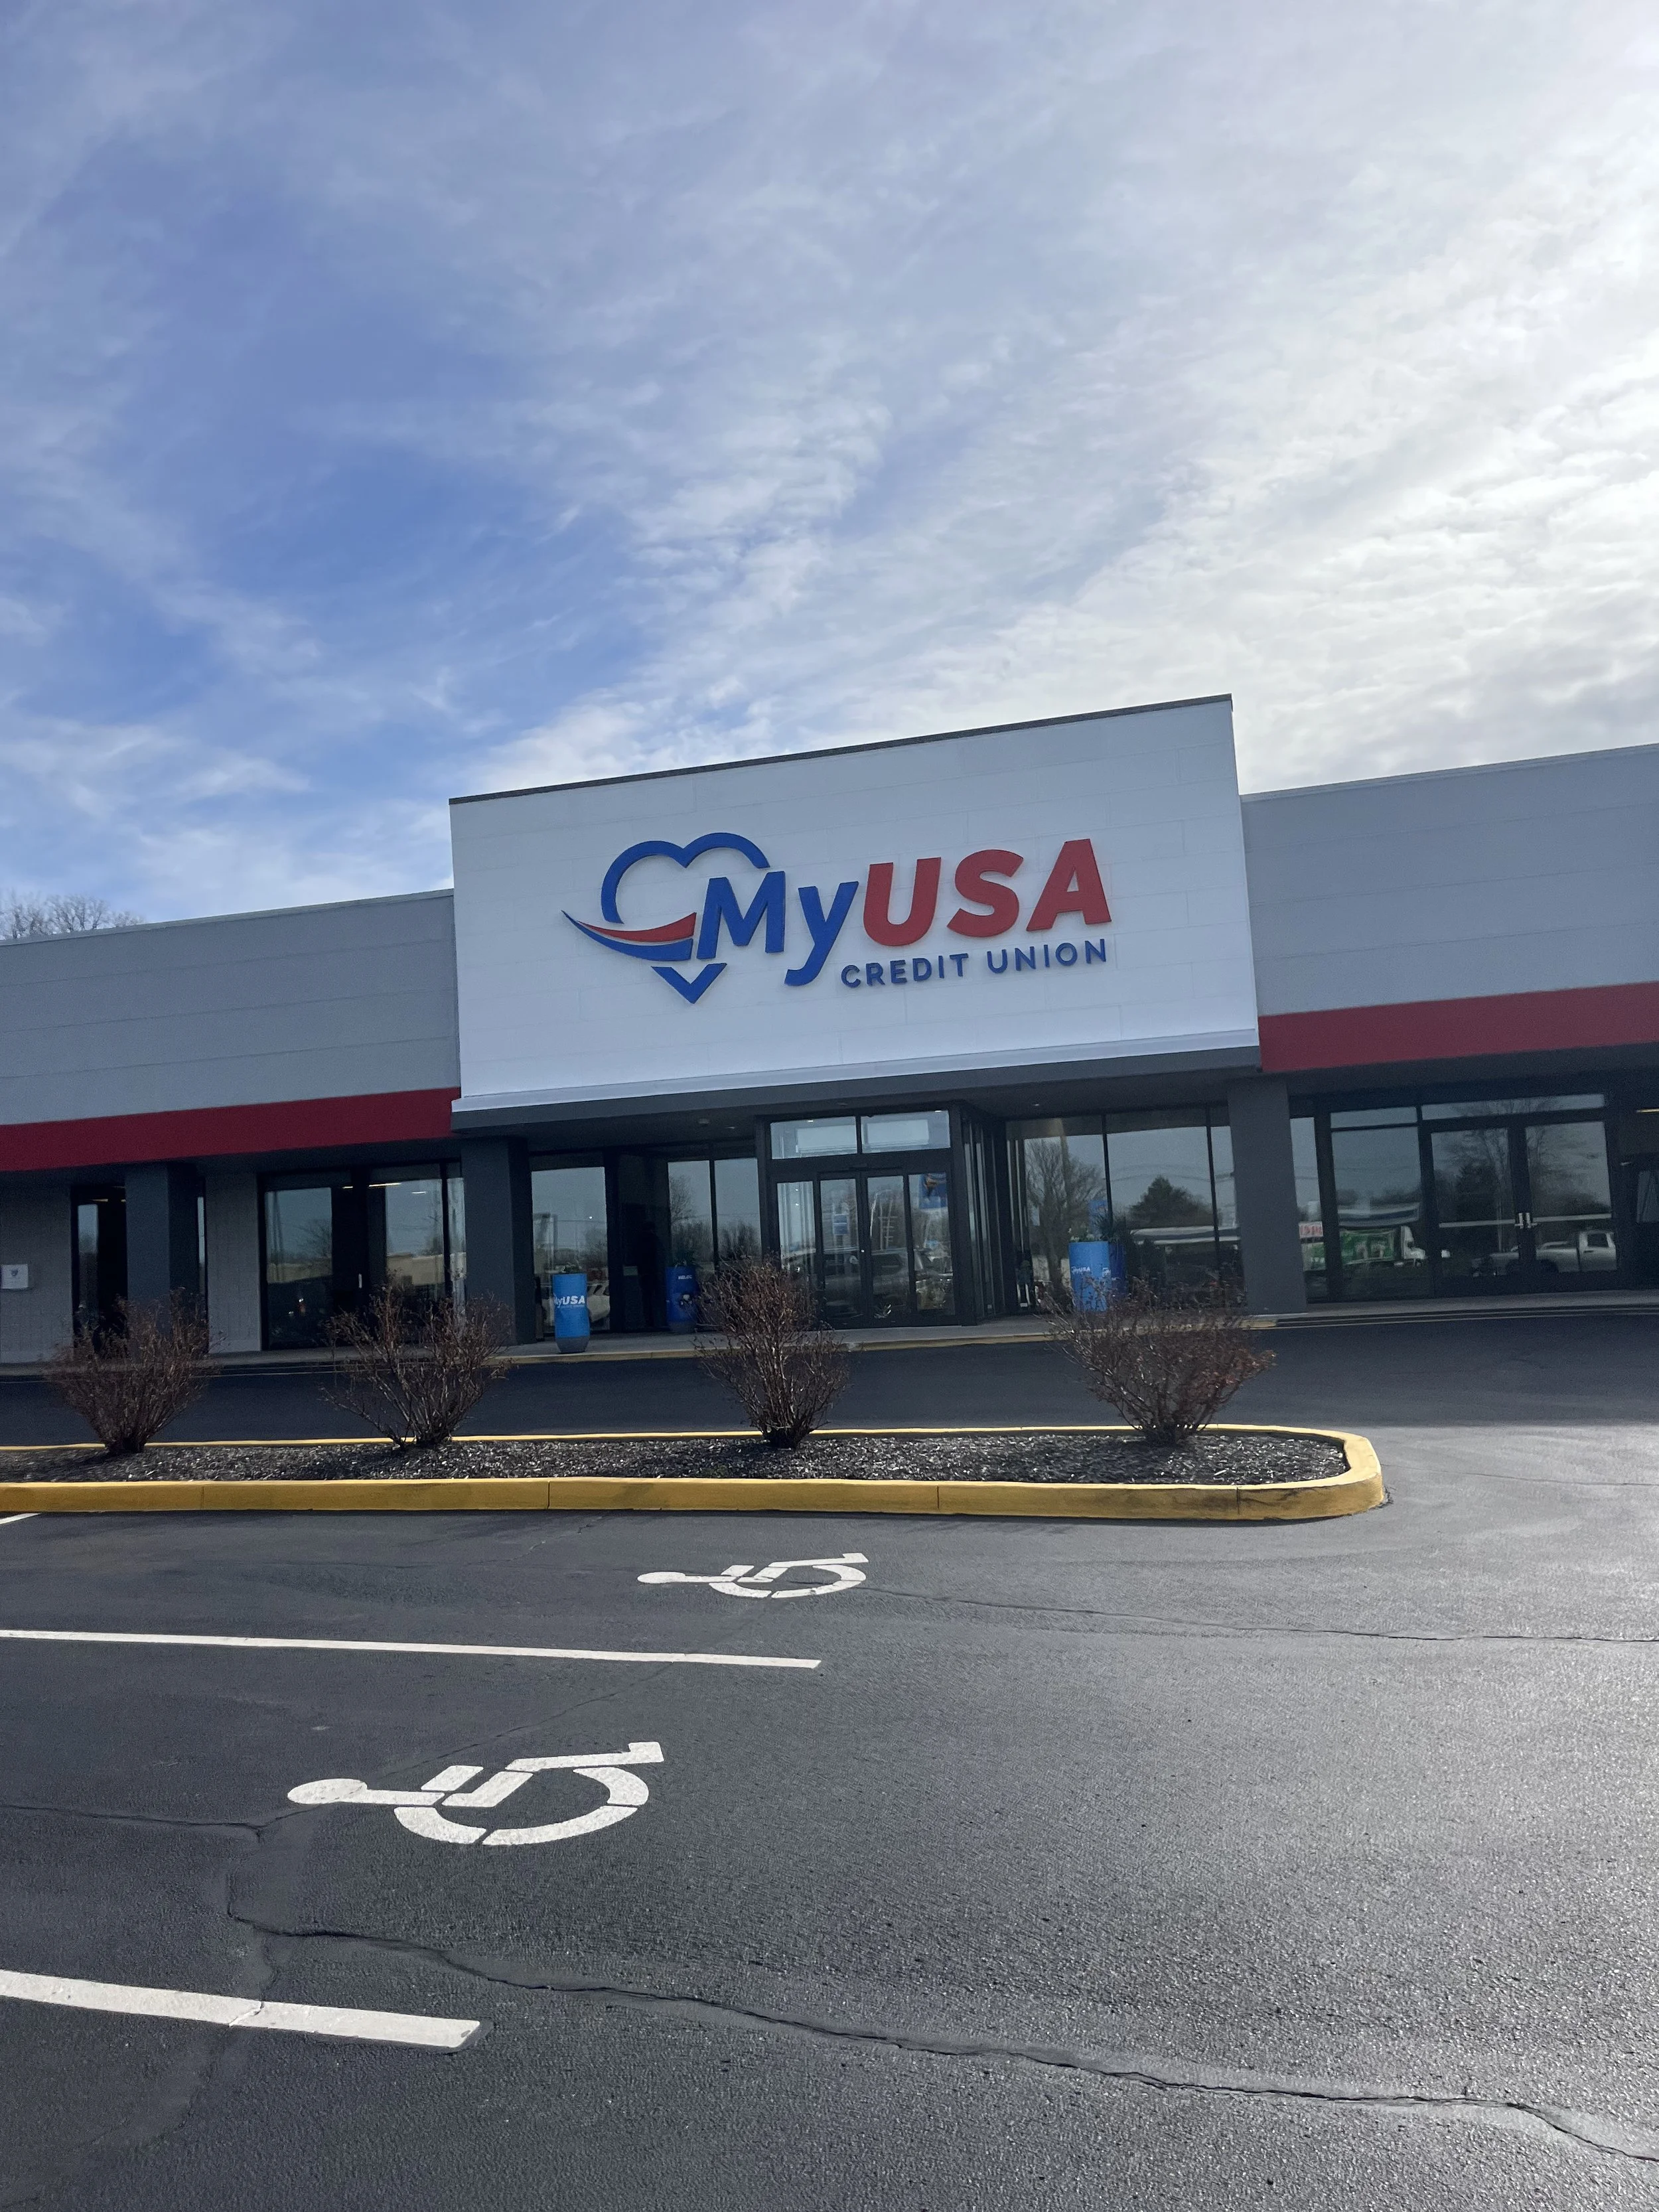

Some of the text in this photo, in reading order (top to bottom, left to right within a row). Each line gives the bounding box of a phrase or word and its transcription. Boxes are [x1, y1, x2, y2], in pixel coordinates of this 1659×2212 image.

[697, 839, 1112, 986] MyUSA
[841, 938, 1106, 988] CREDIT UNION
